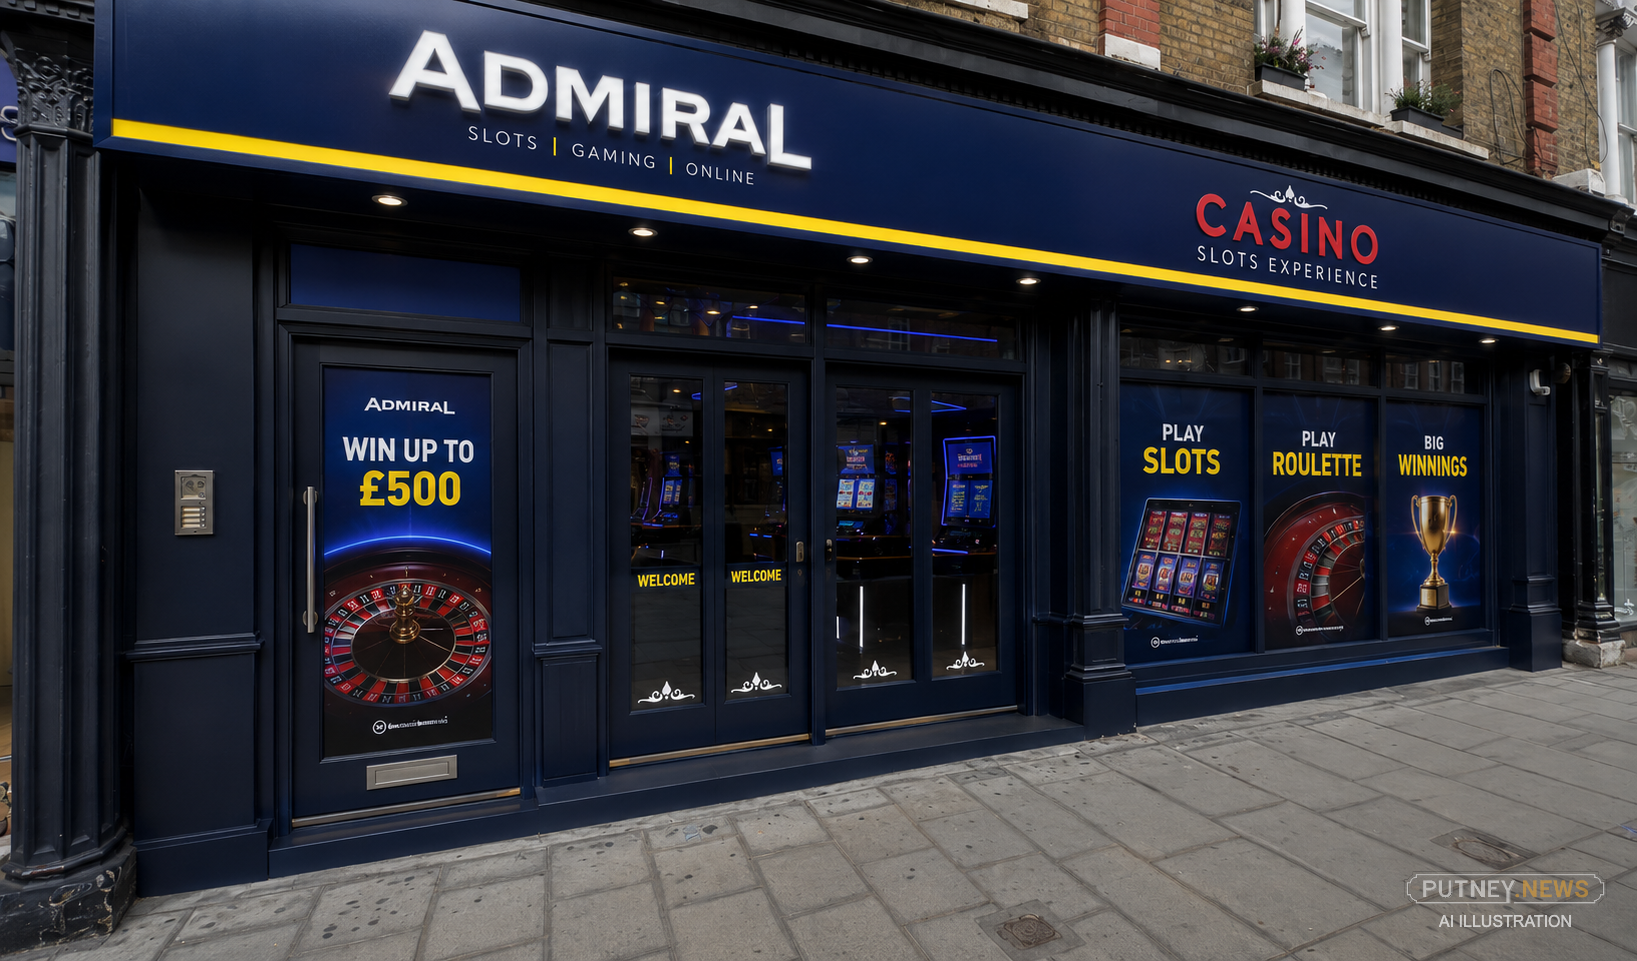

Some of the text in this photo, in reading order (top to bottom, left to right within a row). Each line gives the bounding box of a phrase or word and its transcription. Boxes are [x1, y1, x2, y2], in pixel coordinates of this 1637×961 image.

[389, 30, 812, 170] ADMIRAL
[468, 125, 754, 185] SLOTS GAMING ONLINE
[1196, 193, 1378, 265] CASINO
[1197, 245, 1378, 289] SLOTS EXPERIENCE
[364, 397, 455, 414] ADMIRAL
[1162, 423, 1204, 442] PLAY
[1302, 430, 1336, 447] PLAY
[1424, 435, 1444, 450] BIG
[342, 436, 474, 463] WIN UP TO
[1143, 446, 1220, 475] SLOTS
[1272, 451, 1362, 477] ROULETTE
[1398, 454, 1467, 477] WINNINGS
[360, 470, 461, 506] £500
[637, 572, 695, 587] WELCOME
[731, 569, 782, 583] WELCOME
